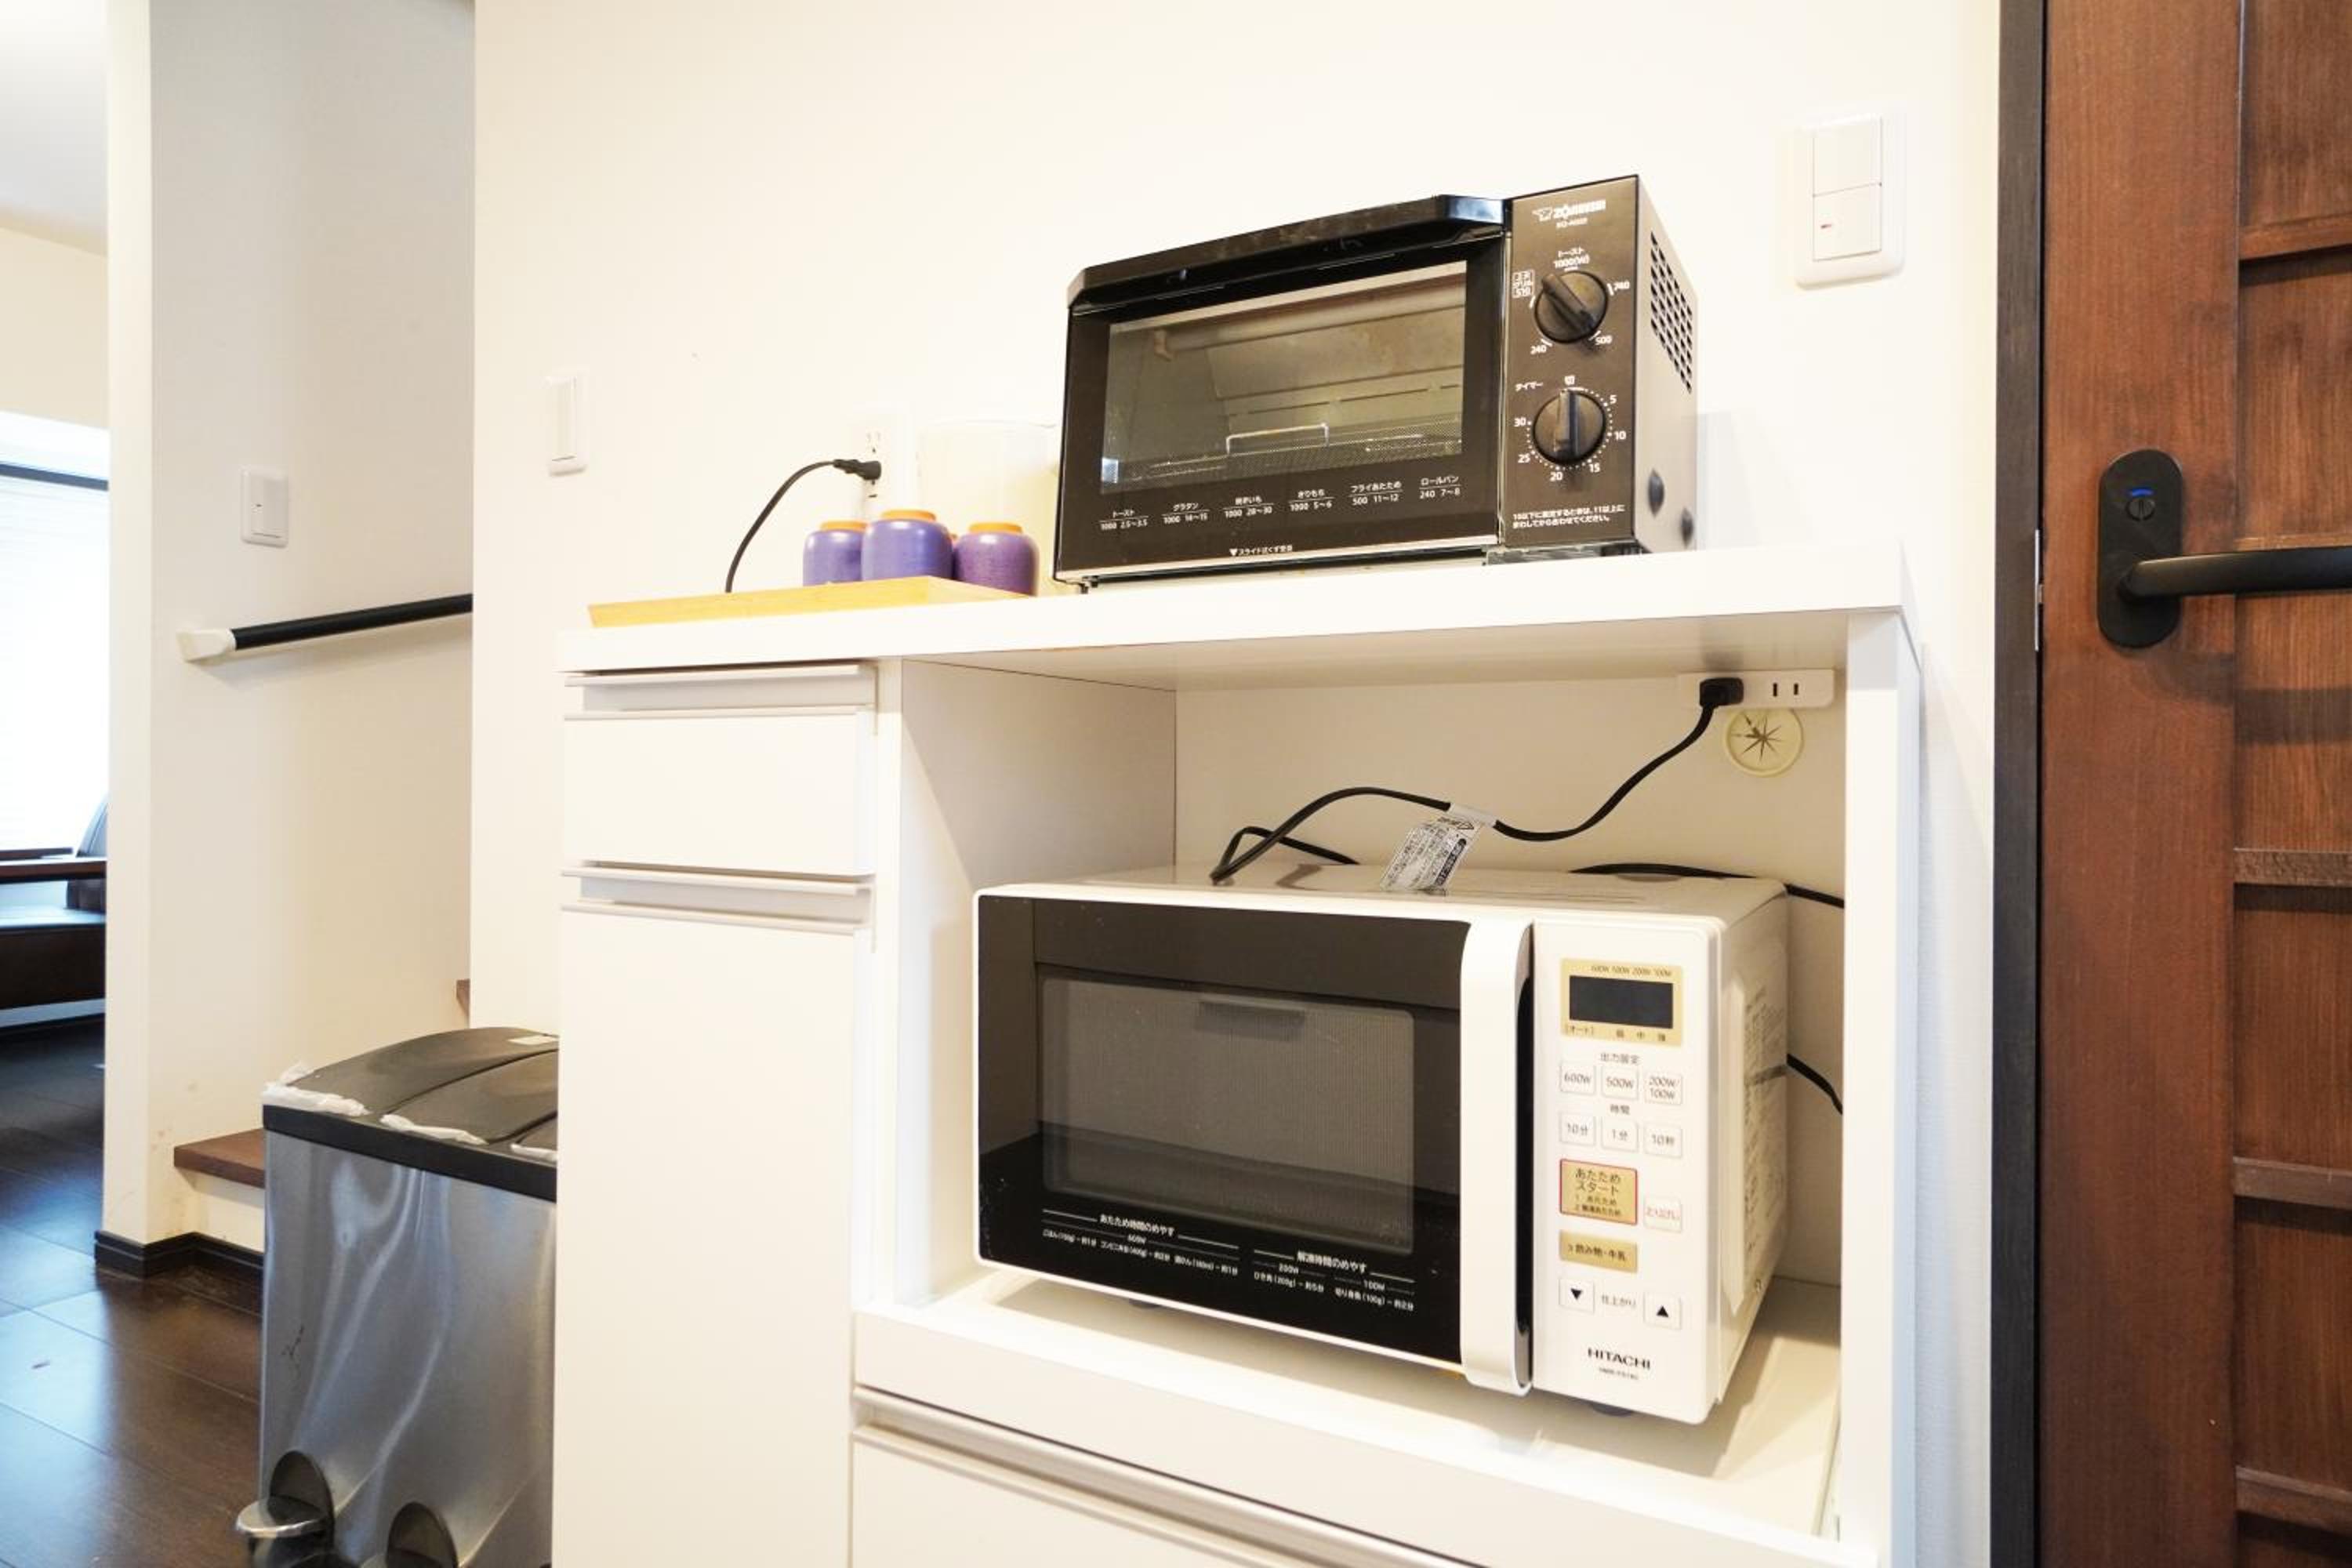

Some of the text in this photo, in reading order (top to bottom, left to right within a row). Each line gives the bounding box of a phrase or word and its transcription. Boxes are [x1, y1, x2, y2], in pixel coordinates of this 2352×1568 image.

[1614, 281, 1630, 291] 740
[1595, 335, 1613, 346] 500
[1530, 345, 1547, 354] 240
[1515, 382, 1543, 391] タイマー
[1610, 395, 1617, 405] 5
[1514, 418, 1526, 427] 30
[1614, 431, 1627, 440] 10
[1518, 454, 1530, 463] 25
[1589, 463, 1600, 474] 15
[1421, 475, 1459, 486] ロールパン
[1550, 472, 1563, 481] 20
[1351, 481, 1402, 493] フライあたため
[1420, 490, 1436, 499] 240
[1352, 496, 1368, 506] 500
[1290, 503, 1309, 512] 1000
[1112, 510, 1134, 518] トースト
[1225, 510, 1243, 519] 1000
[1163, 515, 1180, 524] 1000
[1564, 1072, 1592, 1084] 600W
[1606, 1077, 1634, 1089] 500W
[1650, 1087, 1675, 1099] 100W
[1567, 1123, 1588, 1135] 10分
[1575, 1168, 1621, 1183] あたため
[1577, 1182, 1619, 1196] スタート
[1100, 1214, 1174, 1236] あたため時間のめやす
[1588, 1348, 1650, 1370] HITACHI
